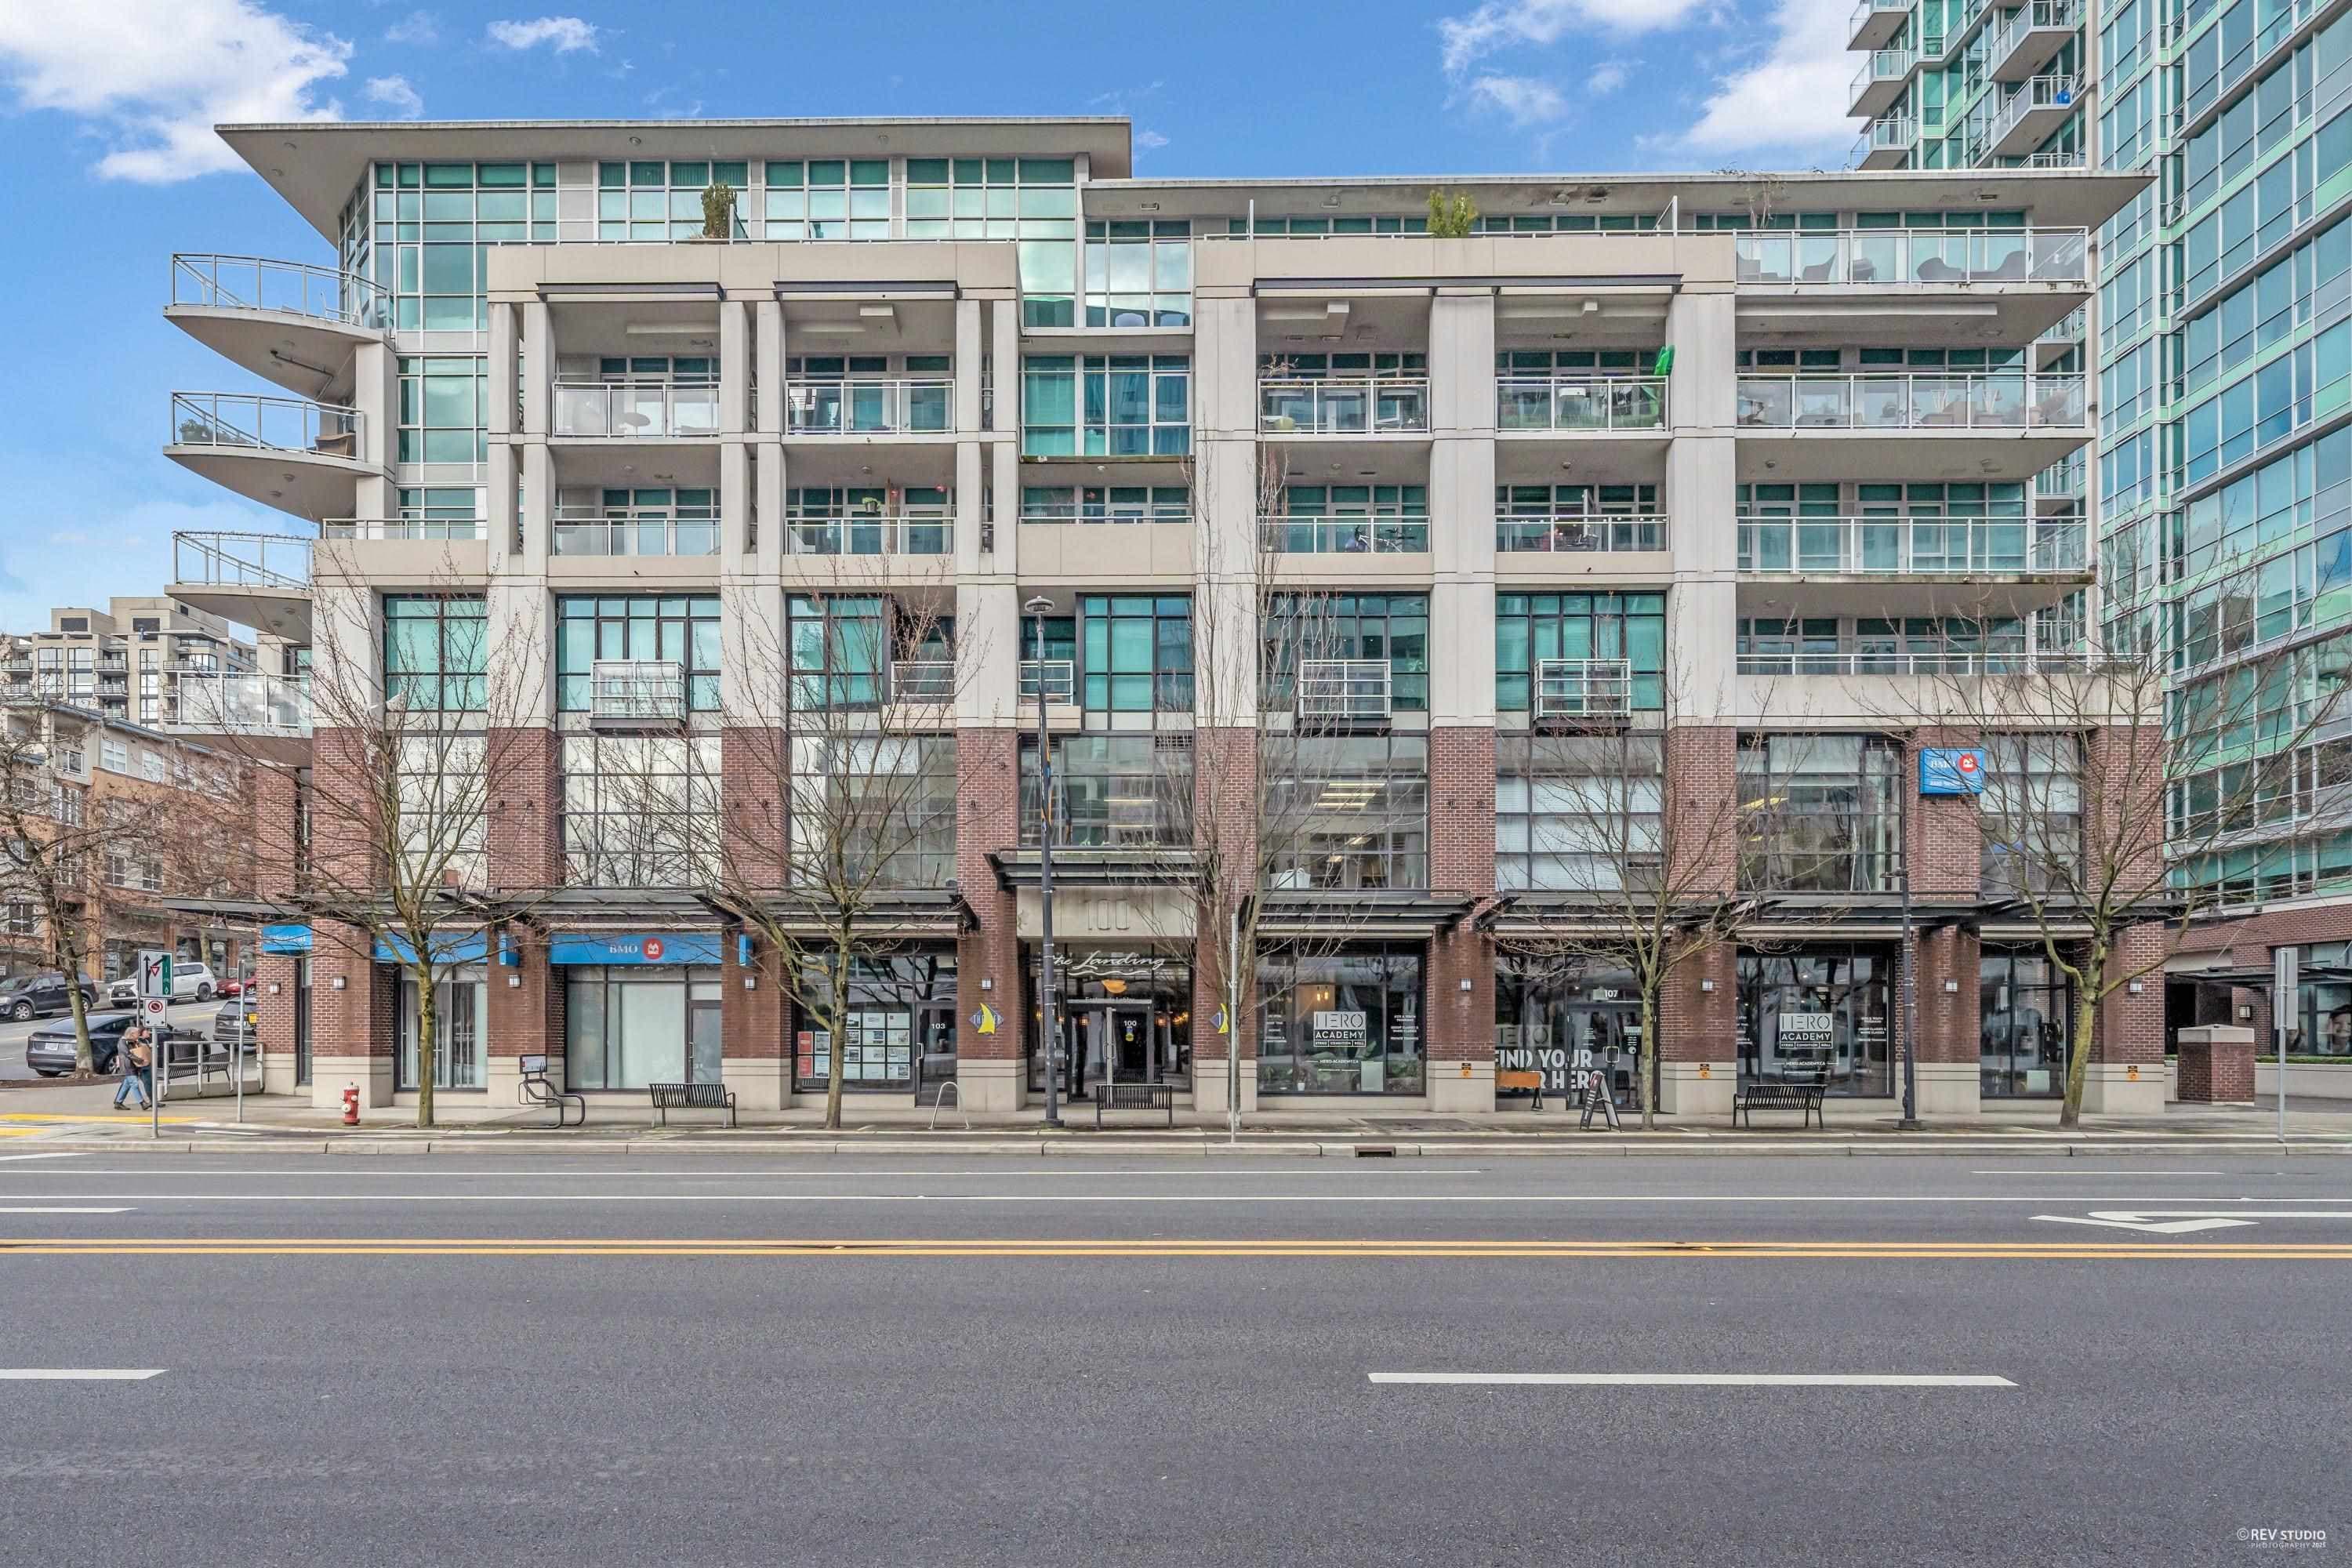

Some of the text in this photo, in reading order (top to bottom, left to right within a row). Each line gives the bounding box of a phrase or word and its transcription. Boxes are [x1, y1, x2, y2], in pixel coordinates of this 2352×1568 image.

[1084, 898, 1130, 931] 100
[609, 945, 638, 953] BMO
[1073, 950, 1166, 971] Landing
[1605, 989, 1618, 998] 107
[1316, 1013, 1363, 1028] HERO
[1782, 1015, 1831, 1029] HERO
[1315, 1030, 1364, 1040] ACADEMY
[1781, 1033, 1831, 1041] ACADEMY
[1537, 1049, 1592, 1068] YOUR
